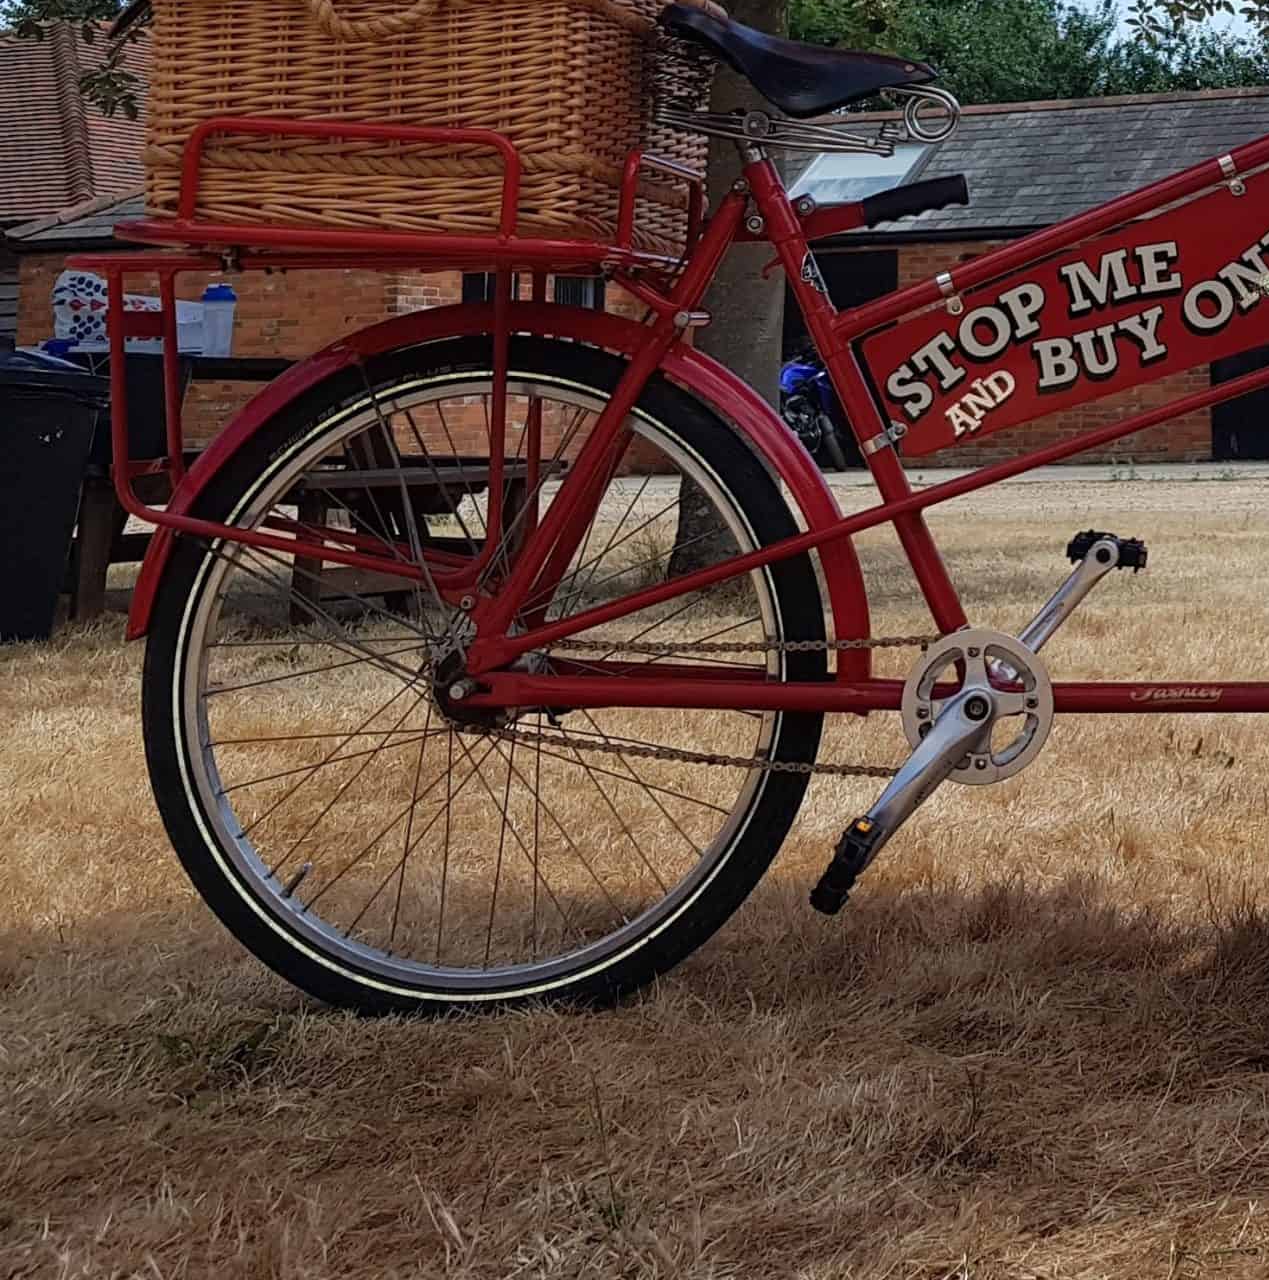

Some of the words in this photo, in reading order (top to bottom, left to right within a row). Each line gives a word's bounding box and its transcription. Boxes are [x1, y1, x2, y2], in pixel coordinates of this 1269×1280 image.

[886, 281, 1046, 417] STOP
[1060, 241, 1183, 314] ME
[943, 369, 1016, 437] AND
[1031, 306, 1168, 390] BUY
